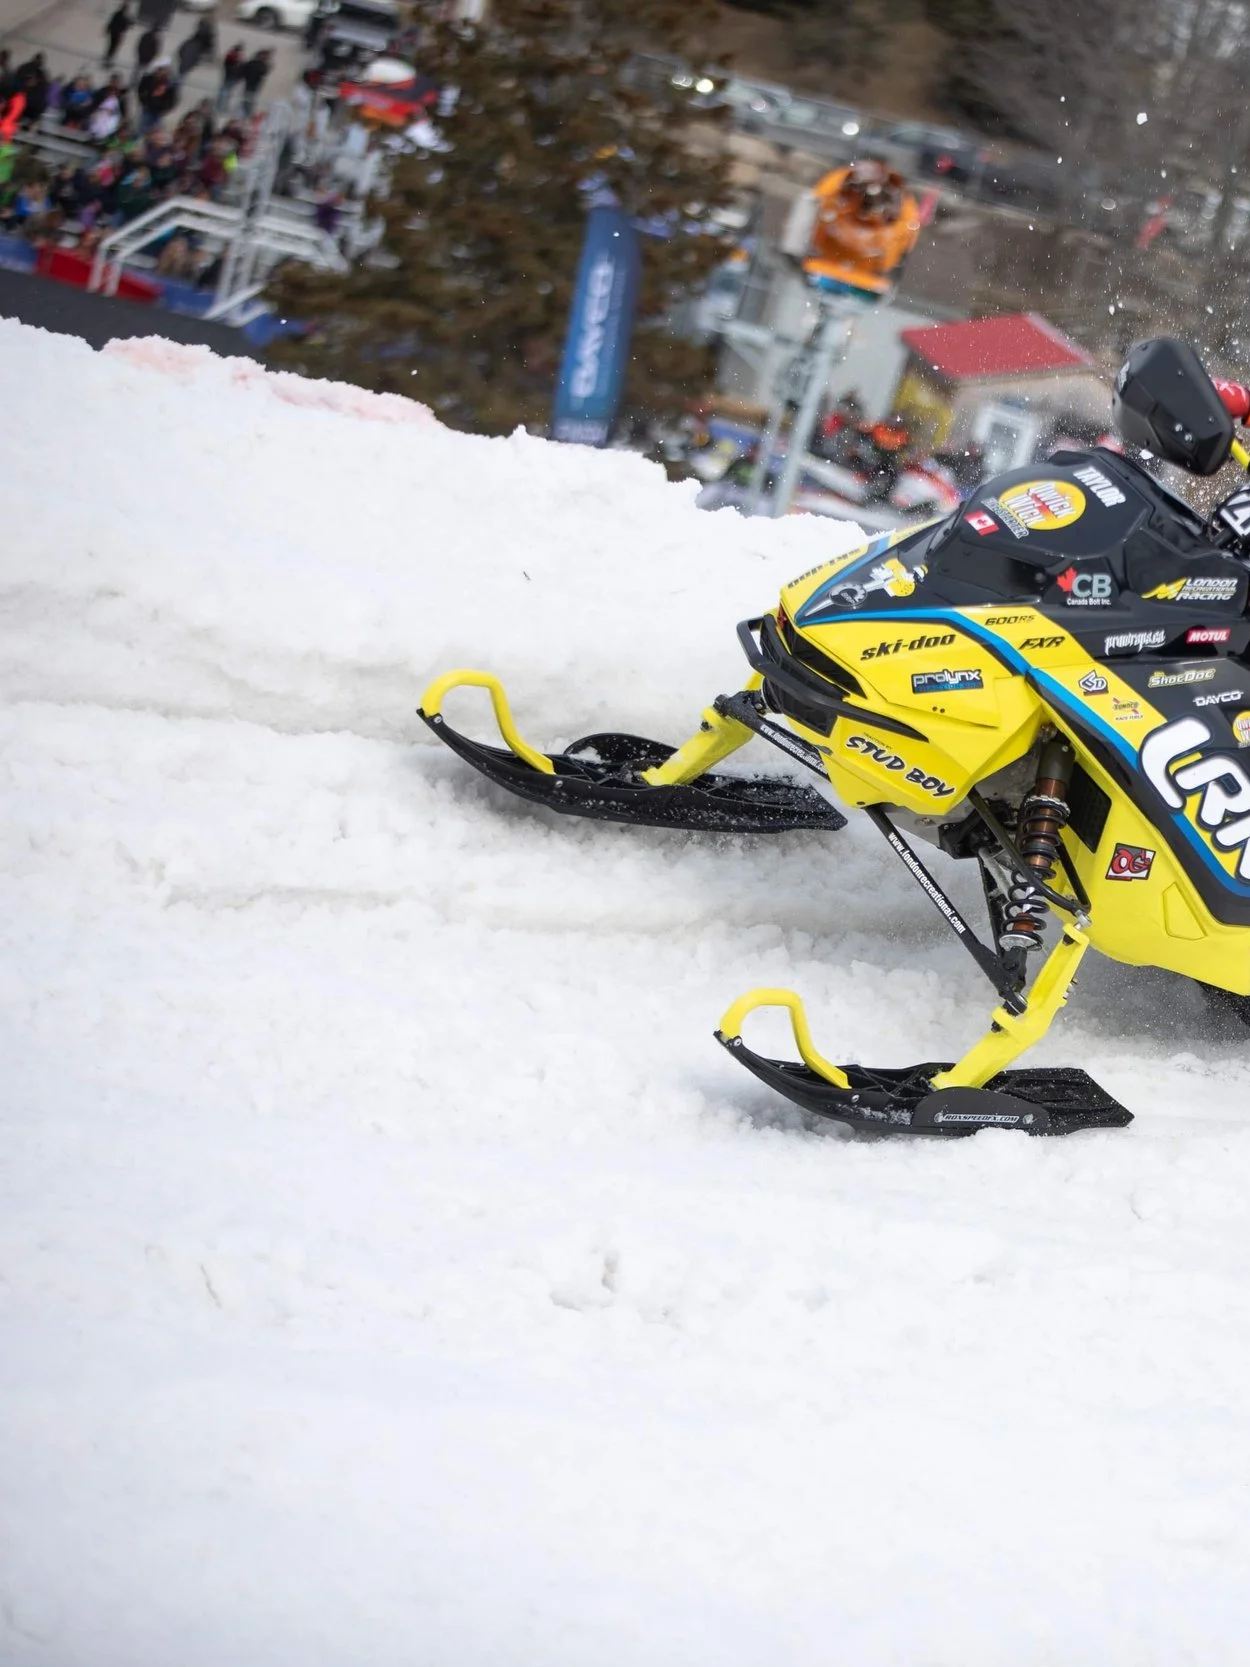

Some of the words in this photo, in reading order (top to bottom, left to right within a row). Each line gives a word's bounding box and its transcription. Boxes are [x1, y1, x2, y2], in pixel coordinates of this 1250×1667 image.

[1073, 465, 1126, 508] TAYLOR
[1072, 573, 1112, 598] CB
[1066, 598, 1088, 606] Canada
[1088, 598, 1101, 606] Bolt
[1101, 598, 1112, 606] Inc.
[860, 634, 957, 661] ski-doo
[1018, 636, 1066, 650] FXR
[1188, 630, 1229, 642] MOTUL
[913, 670, 981, 688] prolynx
[1079, 669, 1108, 692] 6D
[1193, 690, 1244, 706] DAYCO
[845, 736, 906, 771] STUD
[905, 767, 956, 797] BOY
[888, 832, 967, 934] www.londonrecreational.com
